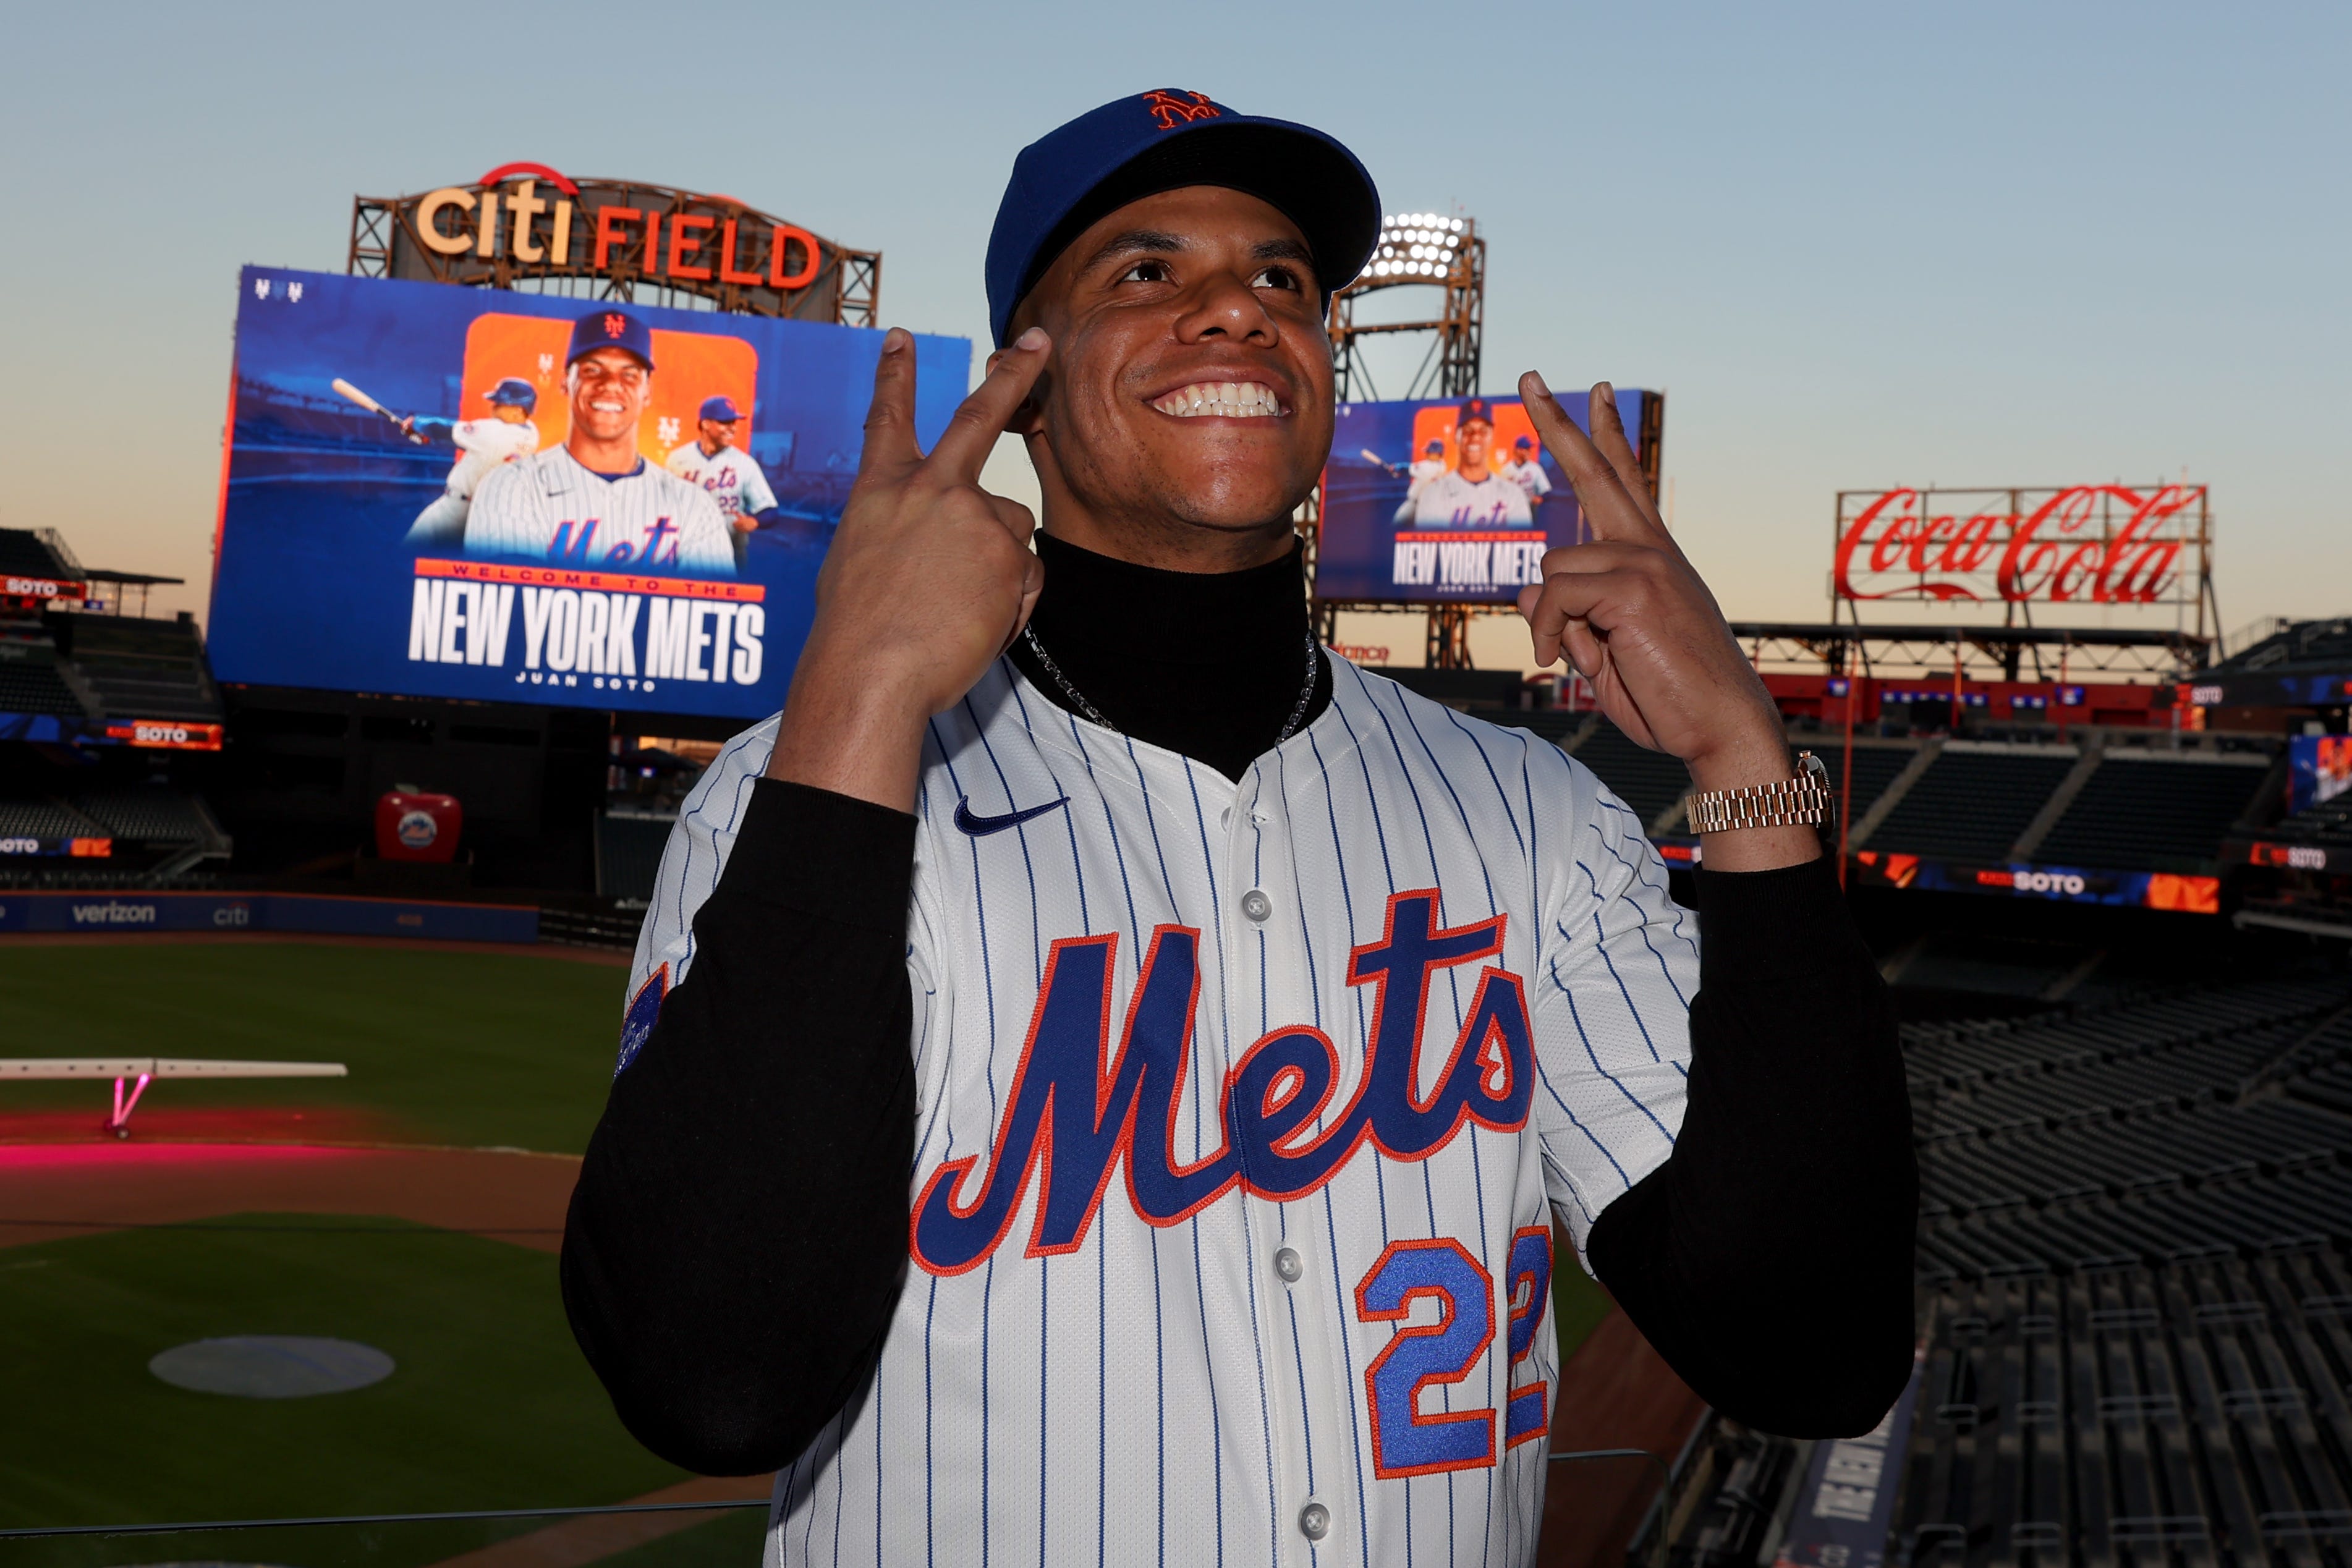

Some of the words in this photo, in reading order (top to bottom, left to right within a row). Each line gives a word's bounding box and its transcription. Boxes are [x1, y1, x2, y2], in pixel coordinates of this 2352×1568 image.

[416, 179, 573, 266] citi
[594, 205, 822, 290] FIELD
[1834, 485, 2208, 603] Coca-Cola
[1393, 541, 1438, 585] NEW
[1439, 541, 1492, 585] YORK
[1492, 541, 1547, 585] METS
[6, 578, 59, 595] SOTO
[452, 564, 601, 587] WELCOME
[627, 578, 660, 591] TO
[686, 583, 737, 598] THE
[408, 578, 515, 667] NEW
[522, 586, 641, 676] YORK
[645, 596, 766, 685] METS
[516, 671, 577, 687] JUAN
[593, 677, 655, 692] SOTO
[135, 726, 188, 743] SOTO
[0, 838, 40, 854] OTO
[2014, 870, 2085, 895] SOTO
[72, 901, 156, 923] verizon
[910, 888, 1536, 1277] Mets
